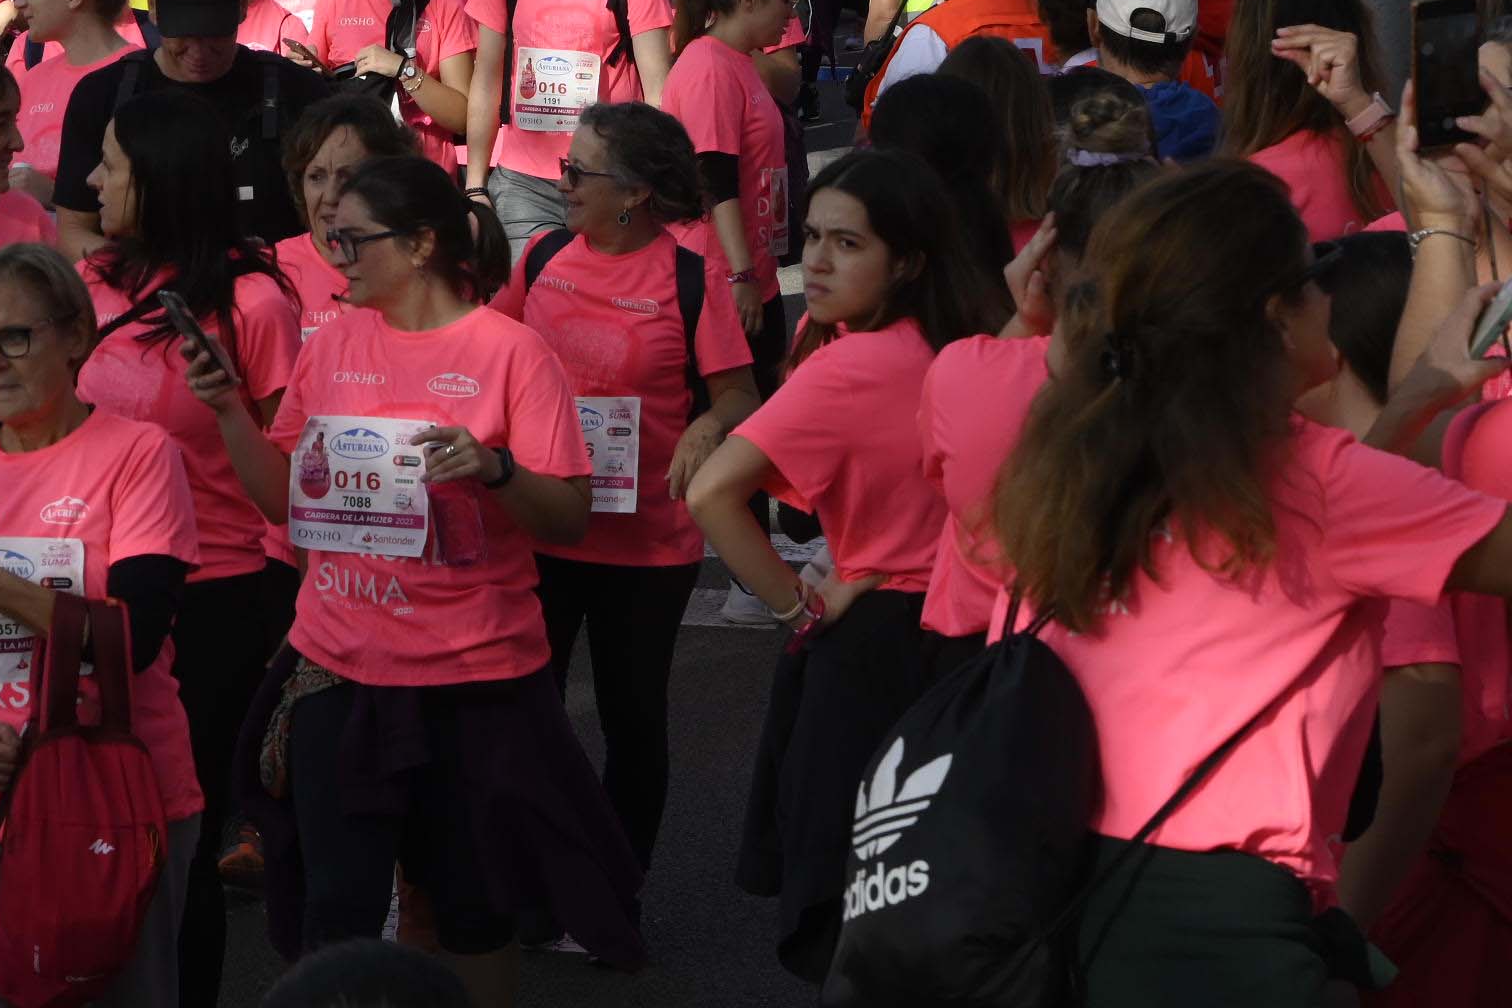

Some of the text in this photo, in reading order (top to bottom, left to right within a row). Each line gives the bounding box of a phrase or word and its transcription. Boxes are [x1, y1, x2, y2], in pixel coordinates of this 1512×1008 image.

[340, 17, 375, 26] OYSHO
[539, 82, 567, 95] 016
[543, 97, 561, 105] 1191
[334, 371, 386, 386] OYSHO
[335, 439, 385, 453] ASTURIANA
[334, 470, 382, 491] 016
[342, 496, 372, 509] 7088
[304, 511, 342, 522] CARRERA
[342, 513, 352, 522] DE
[354, 514, 365, 523] LA
[366, 515, 393, 524] MUJER
[298, 528, 417, 546] OYSHO Santander
[41, 557, 72, 567] SUMA
[315, 561, 409, 605] SUMA
[3, 640, 15, 650] LA
